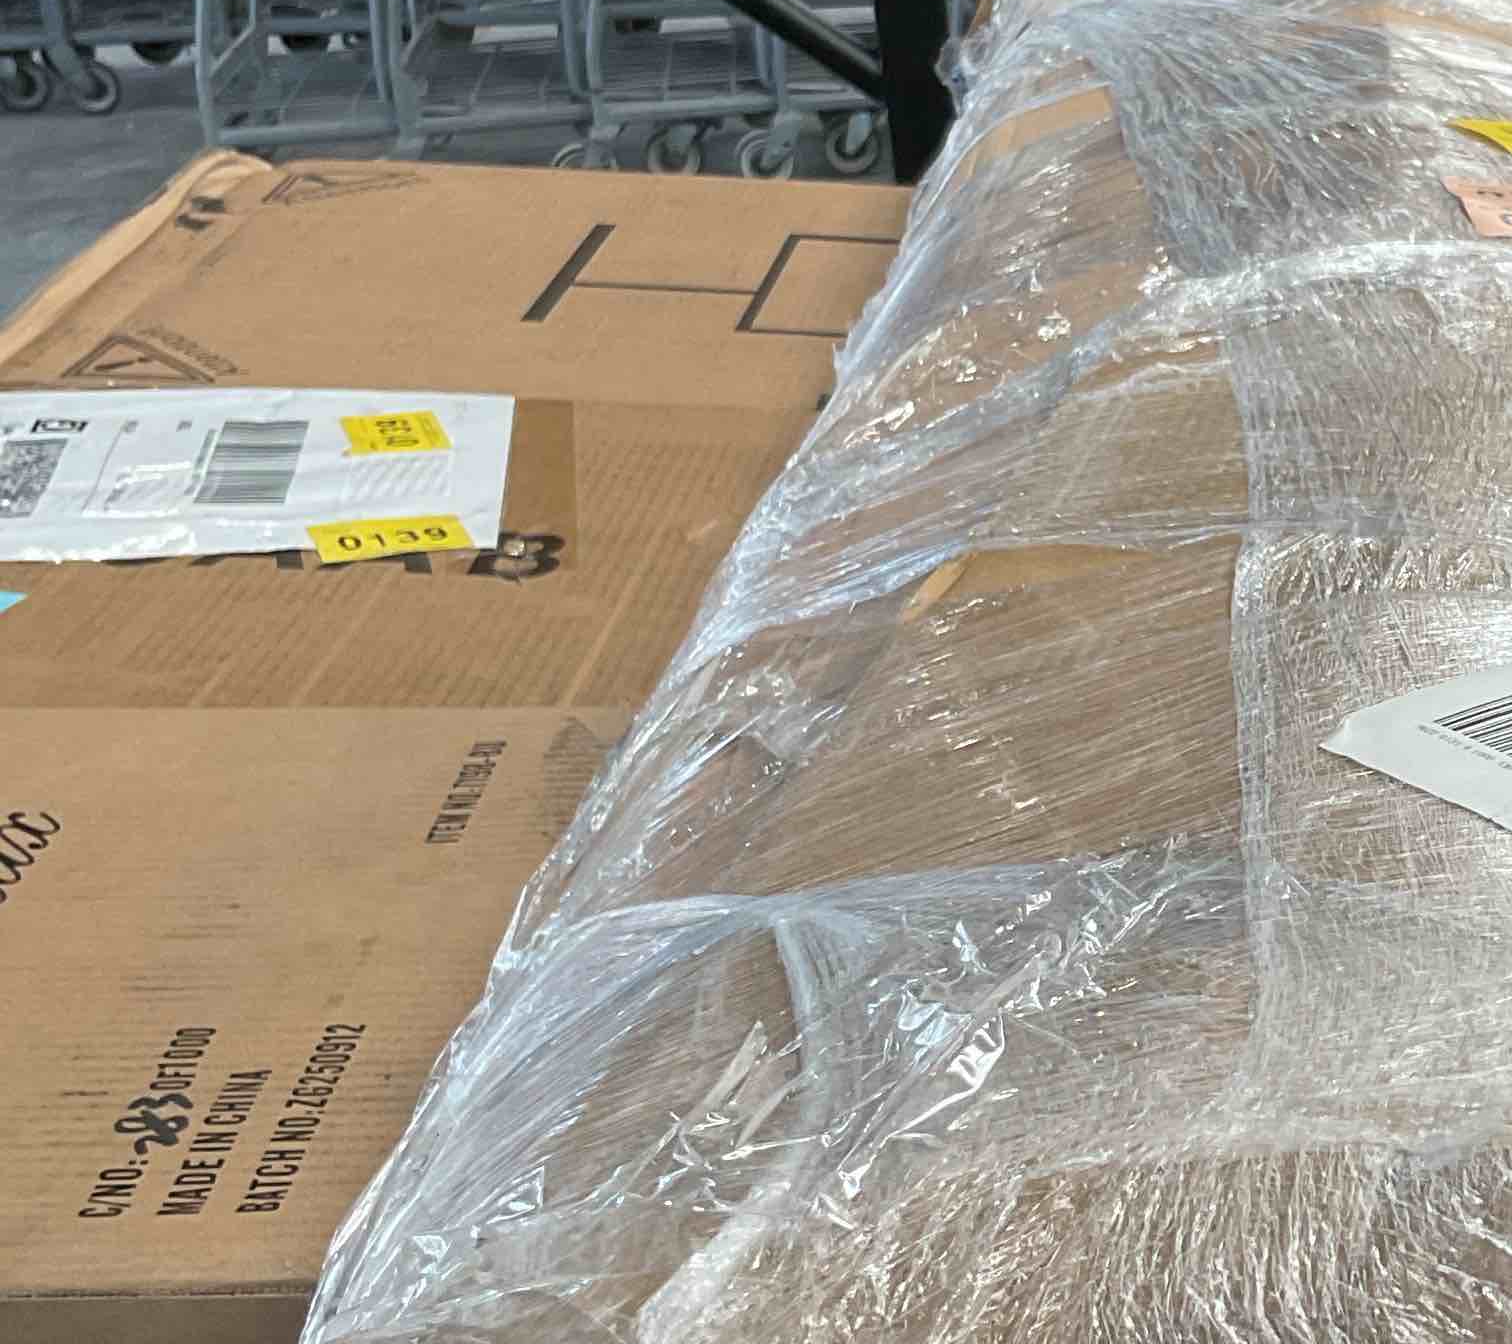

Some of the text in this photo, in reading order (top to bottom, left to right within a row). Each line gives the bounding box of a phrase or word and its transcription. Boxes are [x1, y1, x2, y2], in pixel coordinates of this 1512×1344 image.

[338, 526, 448, 551] 0139
[156, 1069, 273, 1216] MADE IN CHINA
[235, 1149, 306, 1213] BATCH
